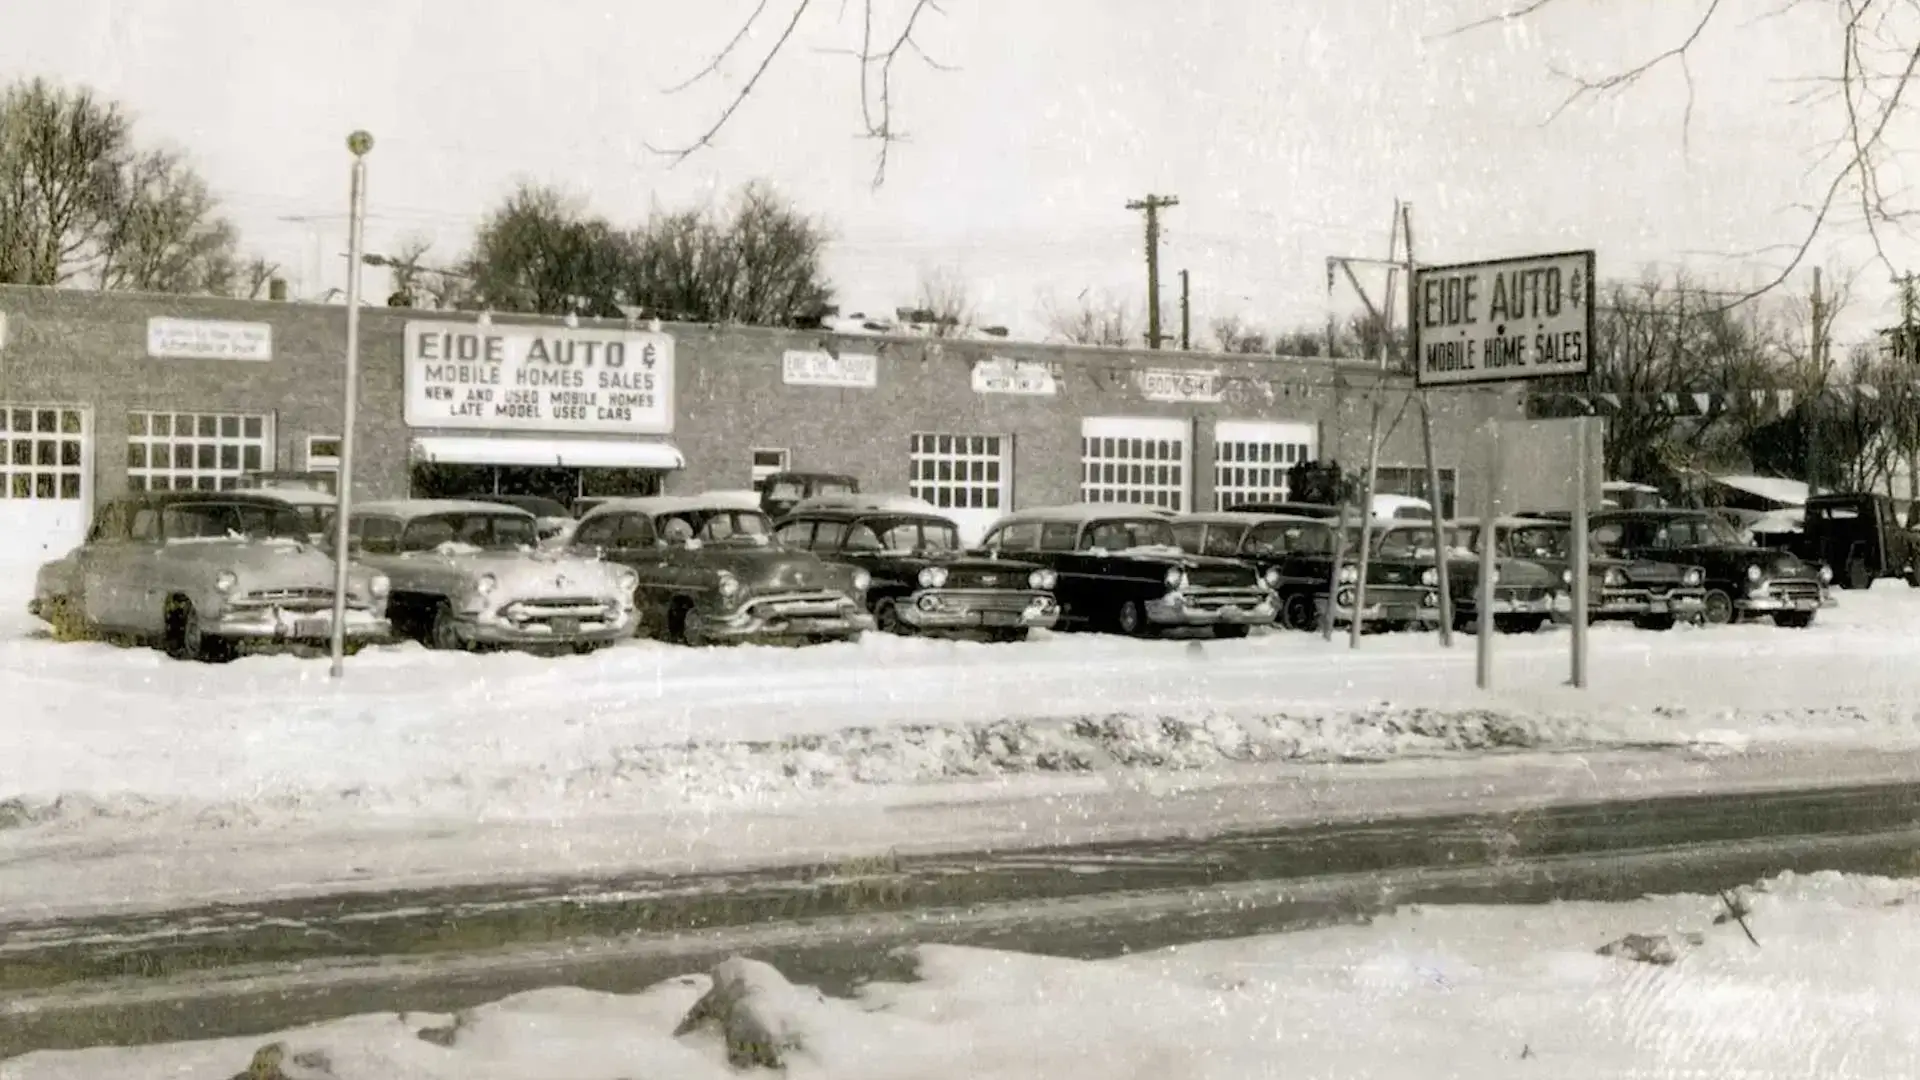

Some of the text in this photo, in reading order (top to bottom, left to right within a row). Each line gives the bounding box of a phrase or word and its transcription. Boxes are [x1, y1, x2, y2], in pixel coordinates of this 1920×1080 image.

[1425, 275, 1478, 328] EIDE
[1490, 266, 1561, 323] AUTO
[418, 332, 504, 362] EIDE
[526, 338, 625, 368] AUTO
[1426, 331, 1582, 372] MOBILE HOME SALES
[425, 364, 655, 390] MOBILE HOMES SALES
[424, 386, 655, 408] NEW AND USED MOBILE HOMES
[450, 402, 632, 421] LATE MODEL USED CARS
